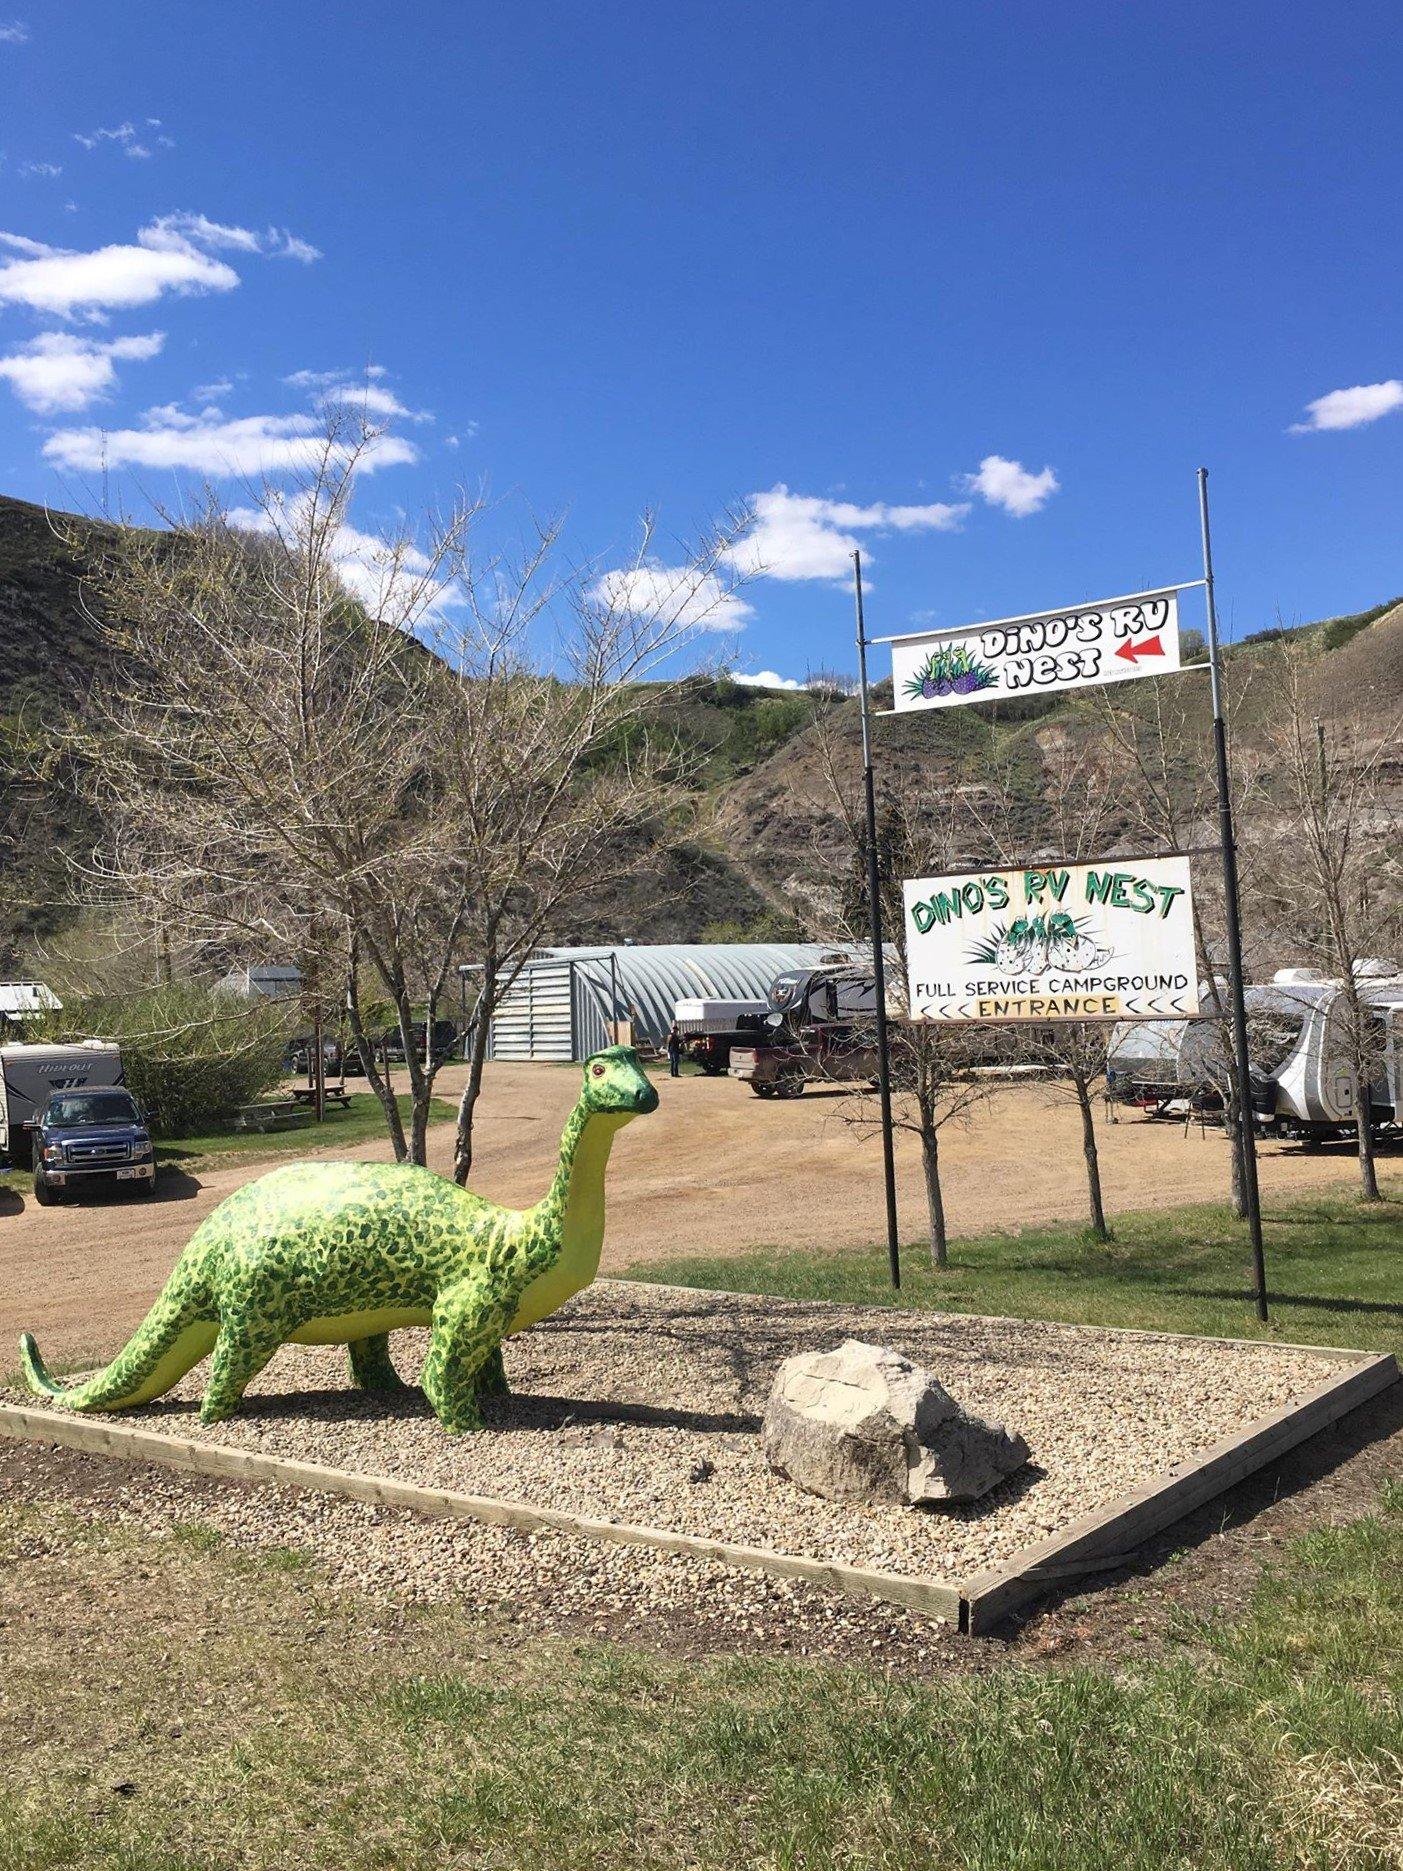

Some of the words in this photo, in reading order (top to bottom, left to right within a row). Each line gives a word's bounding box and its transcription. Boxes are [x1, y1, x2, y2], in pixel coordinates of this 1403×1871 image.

[1110, 599, 1169, 638] RV
[911, 876, 1010, 934] DINO'S
[1024, 870, 1070, 905] RV
[1085, 871, 1185, 919] NEST
[916, 983, 956, 997] FULL
[965, 980, 1040, 997] SERVICE
[1049, 974, 1188, 993] CAMPGROUND
[979, 997, 1116, 1017] ENTRANCE
